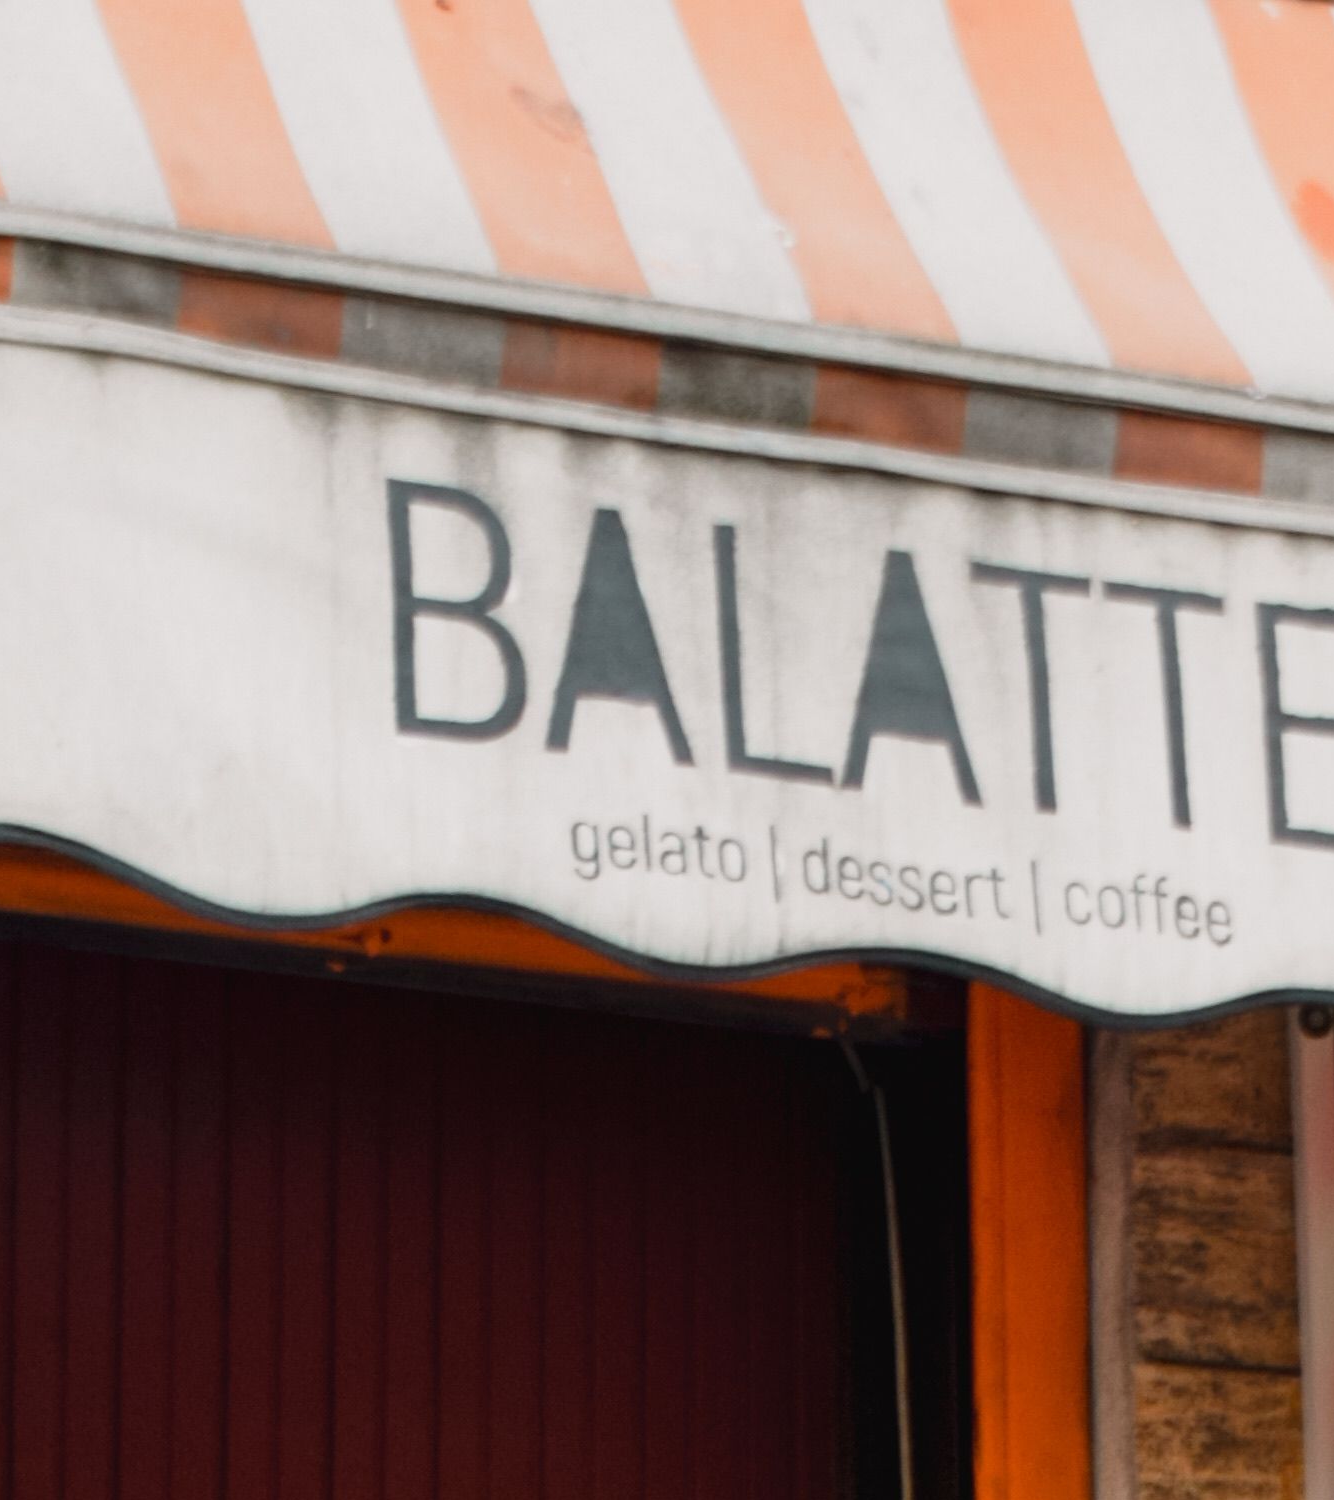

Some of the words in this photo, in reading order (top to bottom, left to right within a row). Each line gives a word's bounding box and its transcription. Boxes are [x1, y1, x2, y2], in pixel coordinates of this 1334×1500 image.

[570, 814, 748, 881] gelato
[803, 838, 1010, 921] dessert
[1064, 874, 1235, 948] coffee
